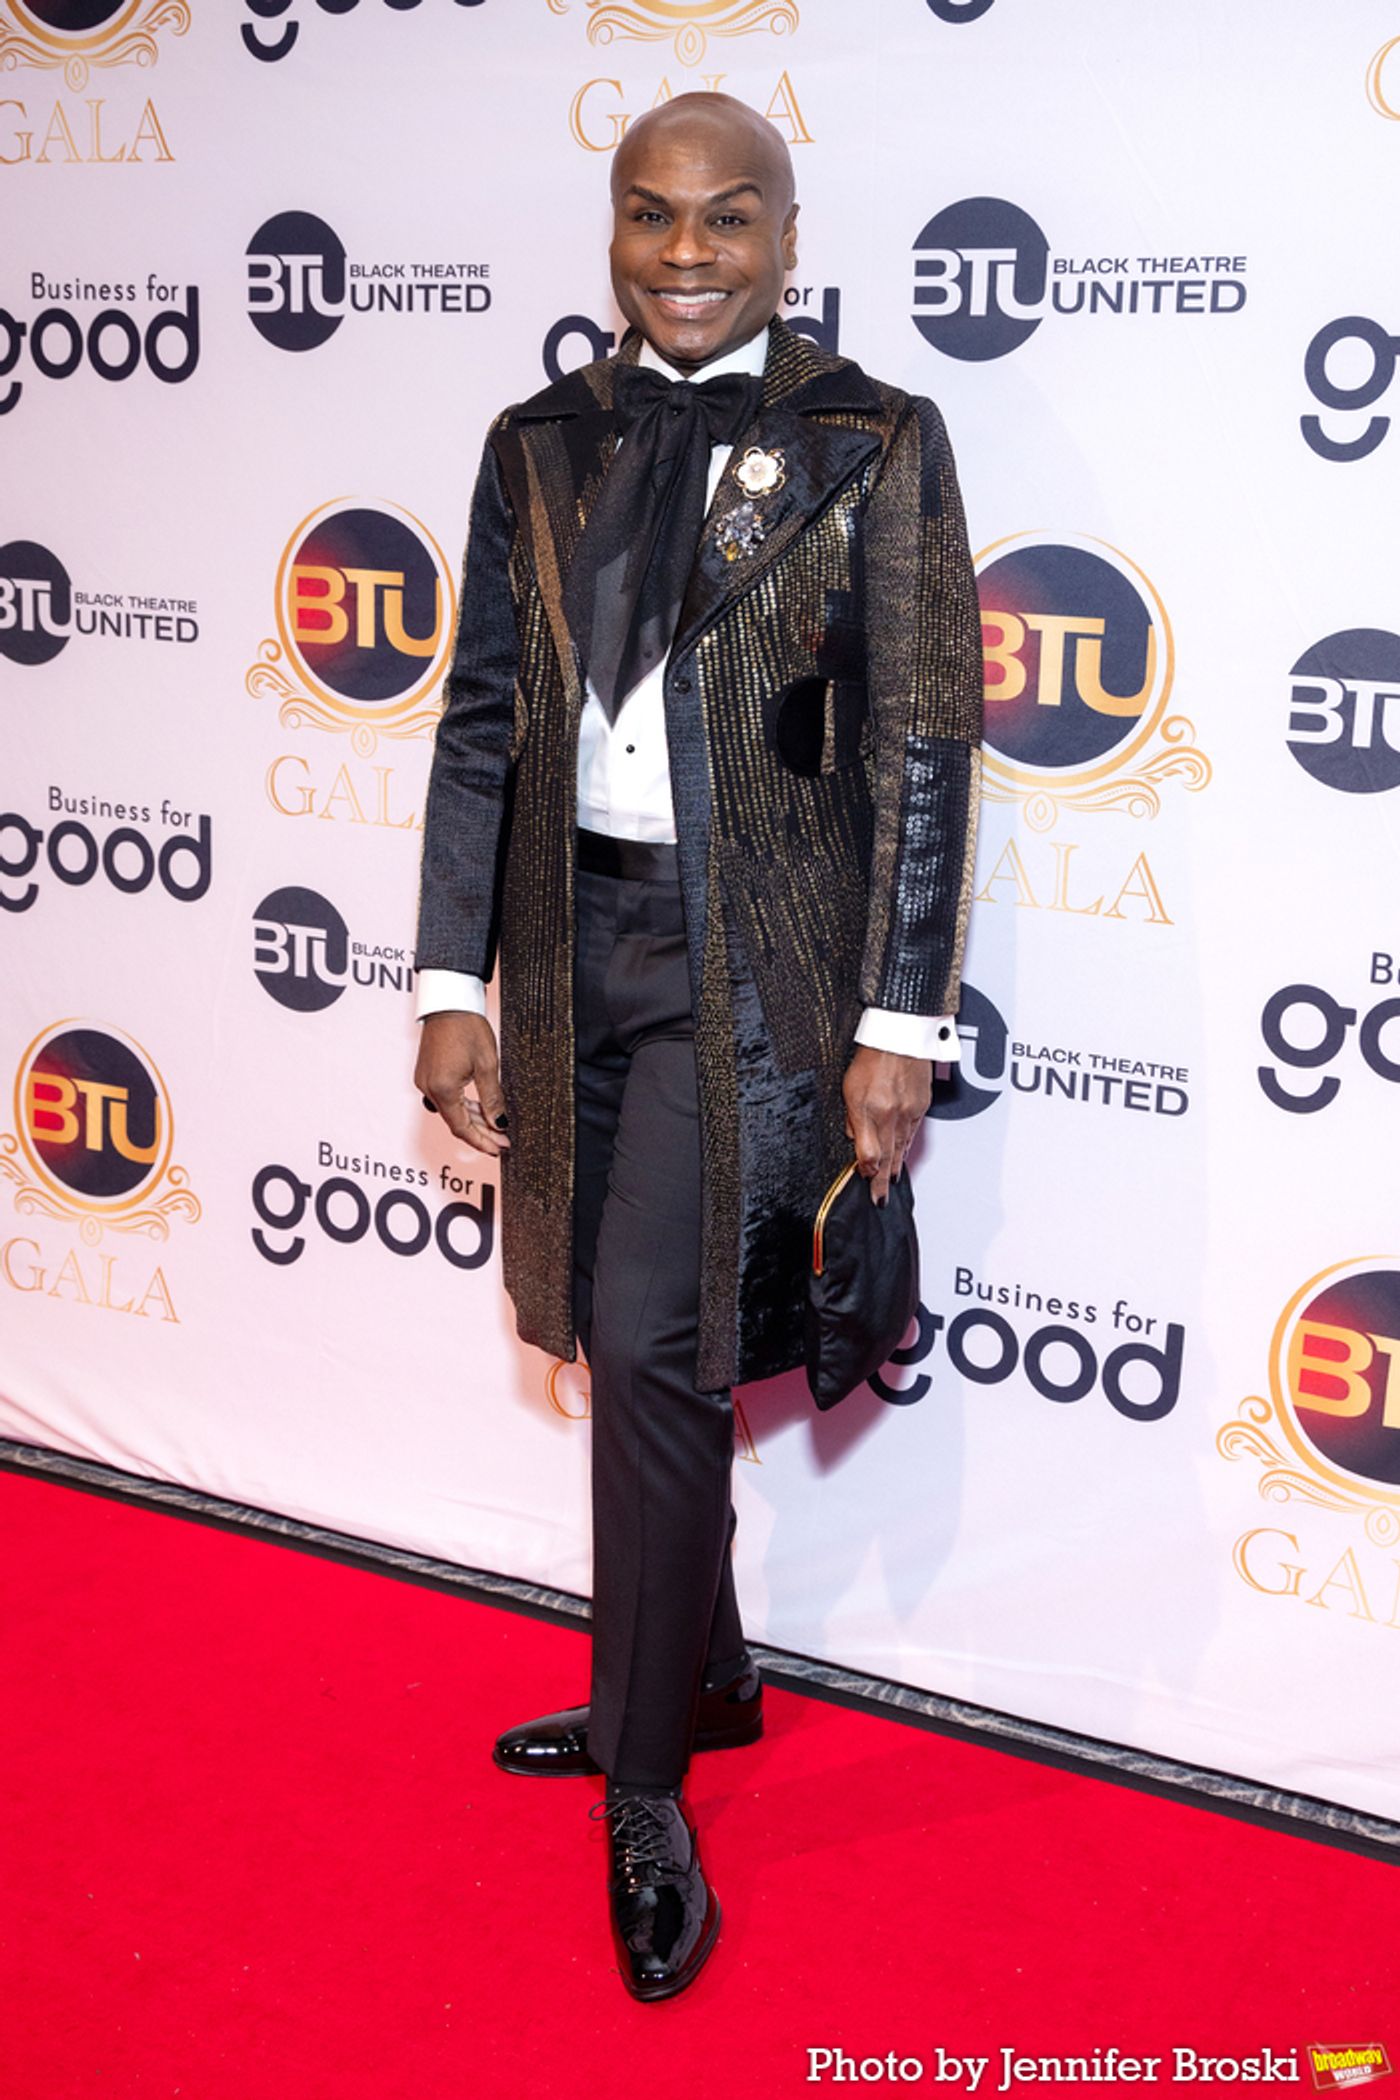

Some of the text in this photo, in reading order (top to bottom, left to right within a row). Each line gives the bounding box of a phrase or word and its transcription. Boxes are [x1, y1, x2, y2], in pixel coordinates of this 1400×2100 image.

[31, 272, 179, 301] Business for
[245, 253, 346, 317] BTU
[350, 264, 490, 278] BLACK THEATRE
[911, 248, 1047, 320] BTU
[1053, 256, 1247, 274] BLACK THEATRE
[351, 284, 492, 312] UNITED
[784, 286, 814, 306] or
[1052, 279, 1247, 314] UNITED
[74, 592, 198, 613] BLACK THEATRE
[76, 609, 199, 644] UNITED
[287, 564, 444, 658] BTU
[48, 786, 192, 827] Business for
[265, 754, 424, 831] GAL
[0, 812, 211, 913] good
[975, 836, 1175, 925] ALA
[252, 918, 349, 987] BTU
[352, 942, 405, 962] BLACK
[352, 959, 413, 993] UNI
[1010, 1061, 1189, 1117] UNITED
[1011, 1042, 1189, 1083] BLACK THEATRE
[25, 1071, 163, 1164] BTU
[318, 1141, 474, 1195] Business for
[252, 1164, 495, 1270] good
[1, 1237, 181, 1324] GALA
[954, 1267, 1158, 1335] Business for
